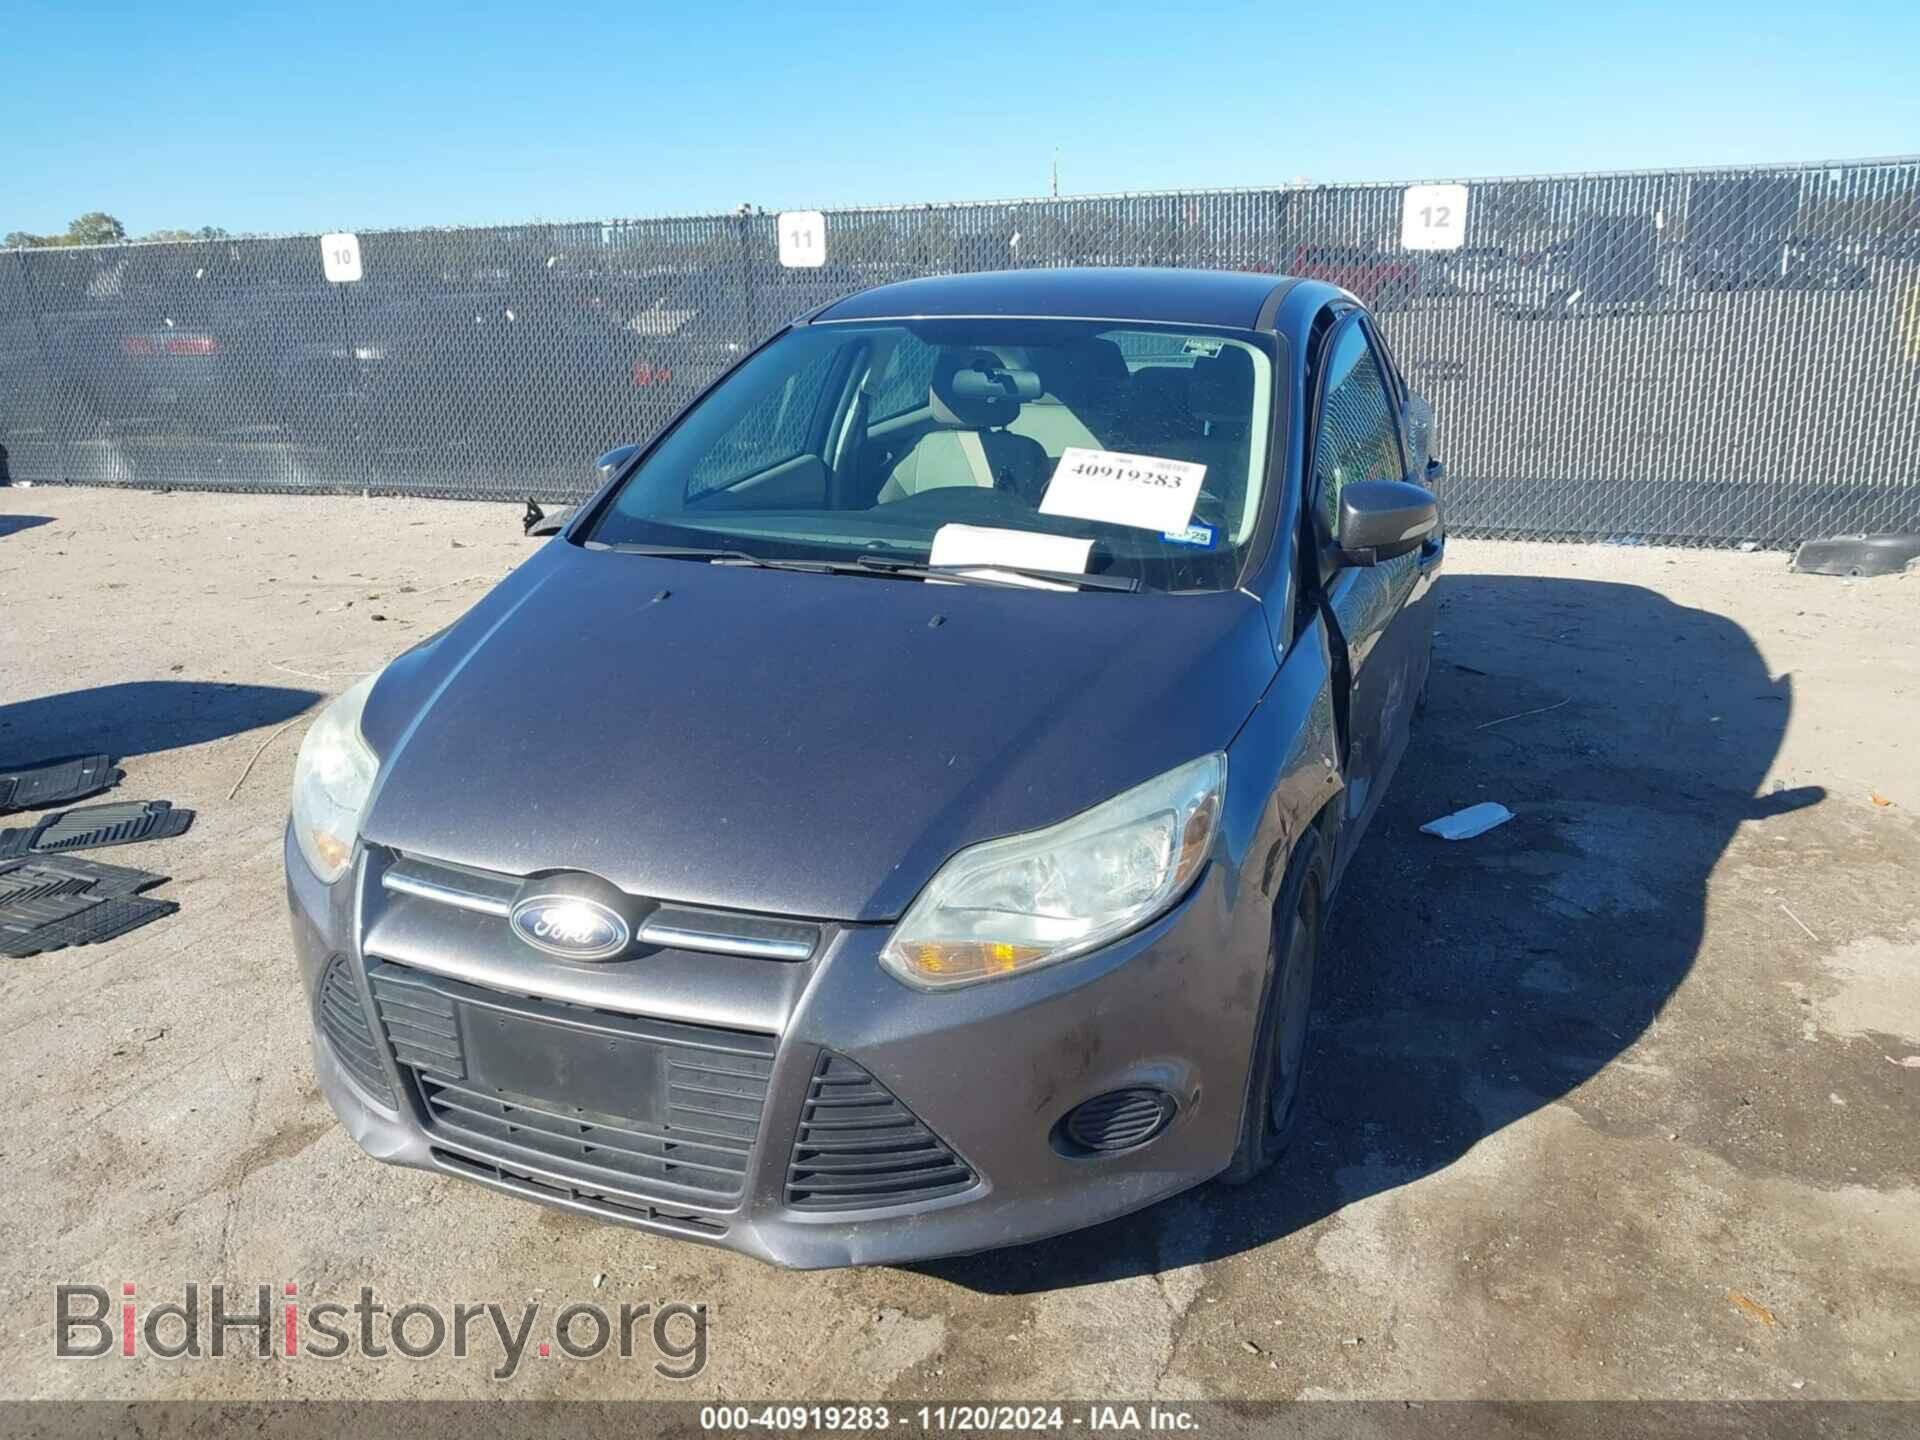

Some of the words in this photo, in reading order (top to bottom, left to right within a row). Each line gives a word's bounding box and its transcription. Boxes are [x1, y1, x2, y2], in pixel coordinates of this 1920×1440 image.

[1419, 206, 1451, 228] 12
[790, 229, 812, 249] 11
[332, 248, 352, 265] 10
[1071, 463, 1183, 488] 40919283
[534, 908, 595, 943] Ford
